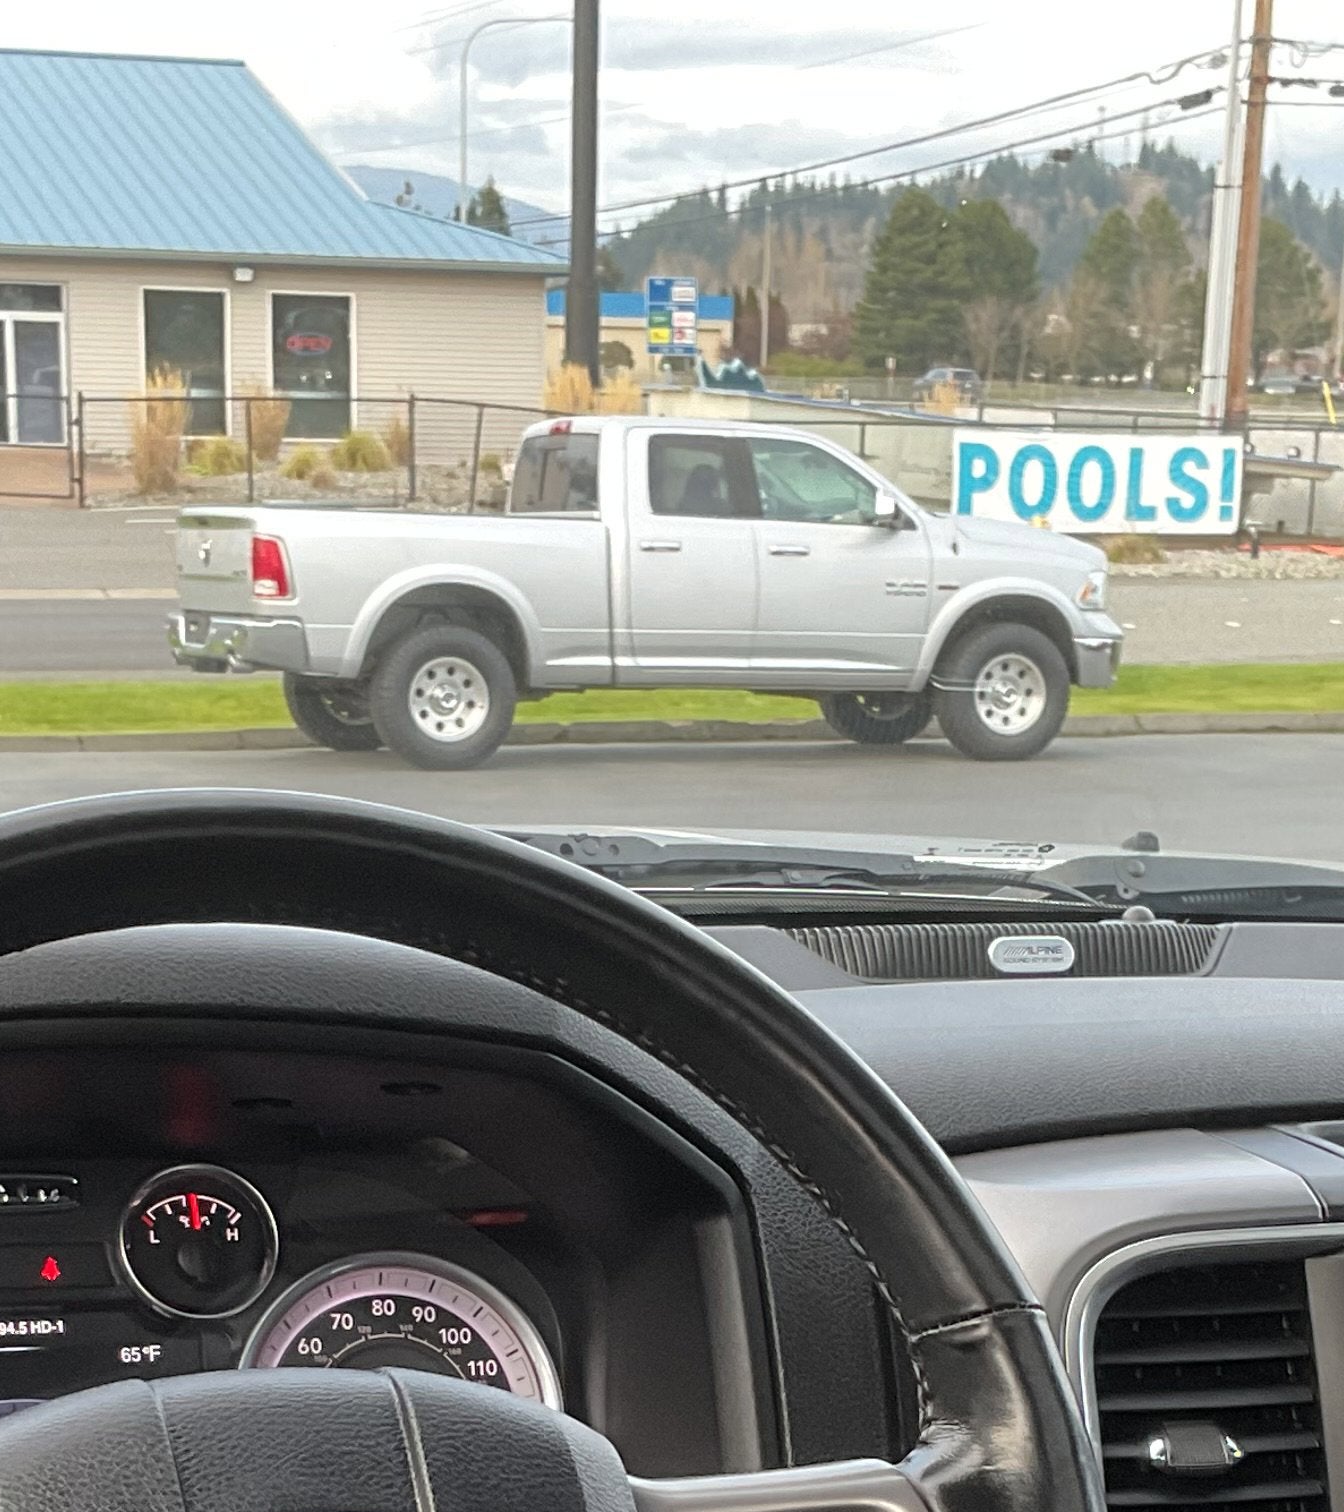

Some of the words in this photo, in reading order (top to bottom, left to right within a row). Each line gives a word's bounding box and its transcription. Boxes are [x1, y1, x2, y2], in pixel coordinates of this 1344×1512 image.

[958, 442, 1236, 524] POOLS!
[150, 1230, 160, 1244] L
[226, 1228, 239, 1241] H
[372, 1300, 396, 1316] 80
[412, 1306, 436, 1323] 90
[30, 1320, 64, 1334] HD-1
[330, 1313, 354, 1330] 70
[439, 1328, 471, 1344] 100
[120, 1345, 161, 1362] 65°F
[297, 1338, 322, 1354] 60
[467, 1360, 497, 1376] 110
